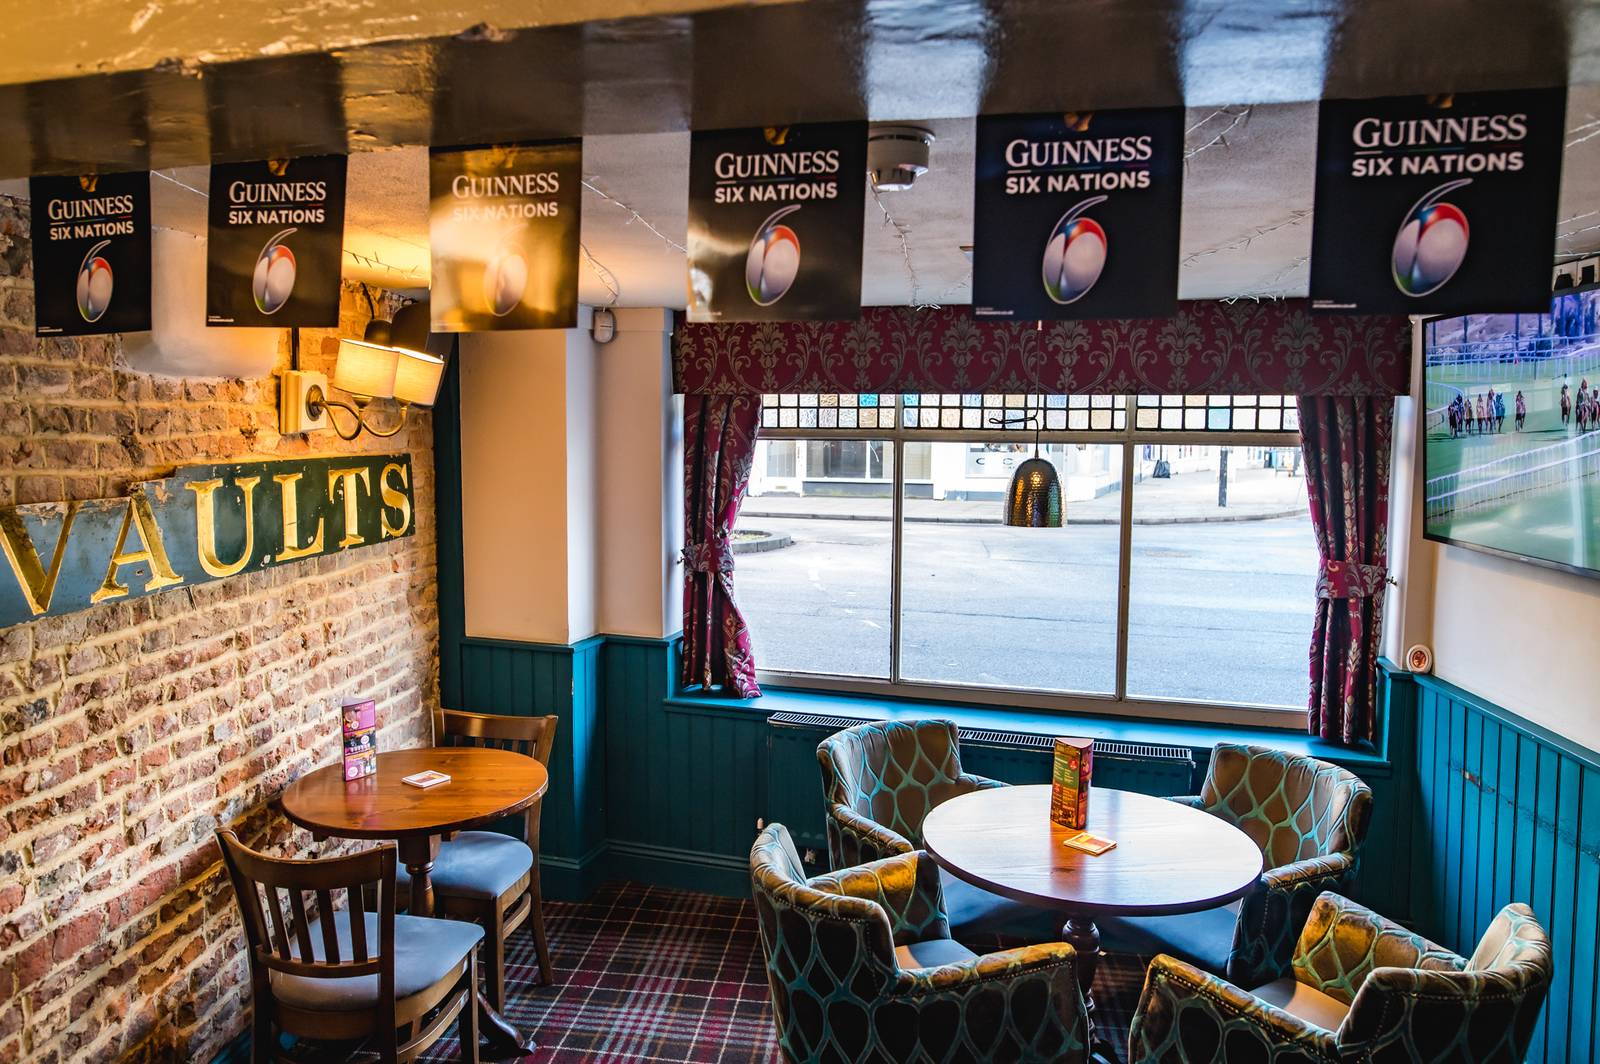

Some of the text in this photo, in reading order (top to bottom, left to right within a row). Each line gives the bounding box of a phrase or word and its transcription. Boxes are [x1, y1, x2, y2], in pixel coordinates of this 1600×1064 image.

[1352, 113, 1527, 151] GUINNESS
[715, 150, 840, 180] GUINNESS
[1005, 135, 1153, 170] GUINNESS
[1351, 149, 1524, 178] SIX NATIONS
[229, 181, 327, 204] GUINNESS
[452, 172, 560, 199] GUINNESS
[714, 181, 838, 203] SIX NATIONS
[1005, 169, 1151, 195] SIX NATIONS
[48, 195, 133, 221] GUINNESS
[228, 207, 325, 225] SIX NATIONS
[453, 200, 559, 222] SIX NATIONS
[50, 220, 134, 241] SIX NATIONS
[0, 462, 412, 616] VAULTS
